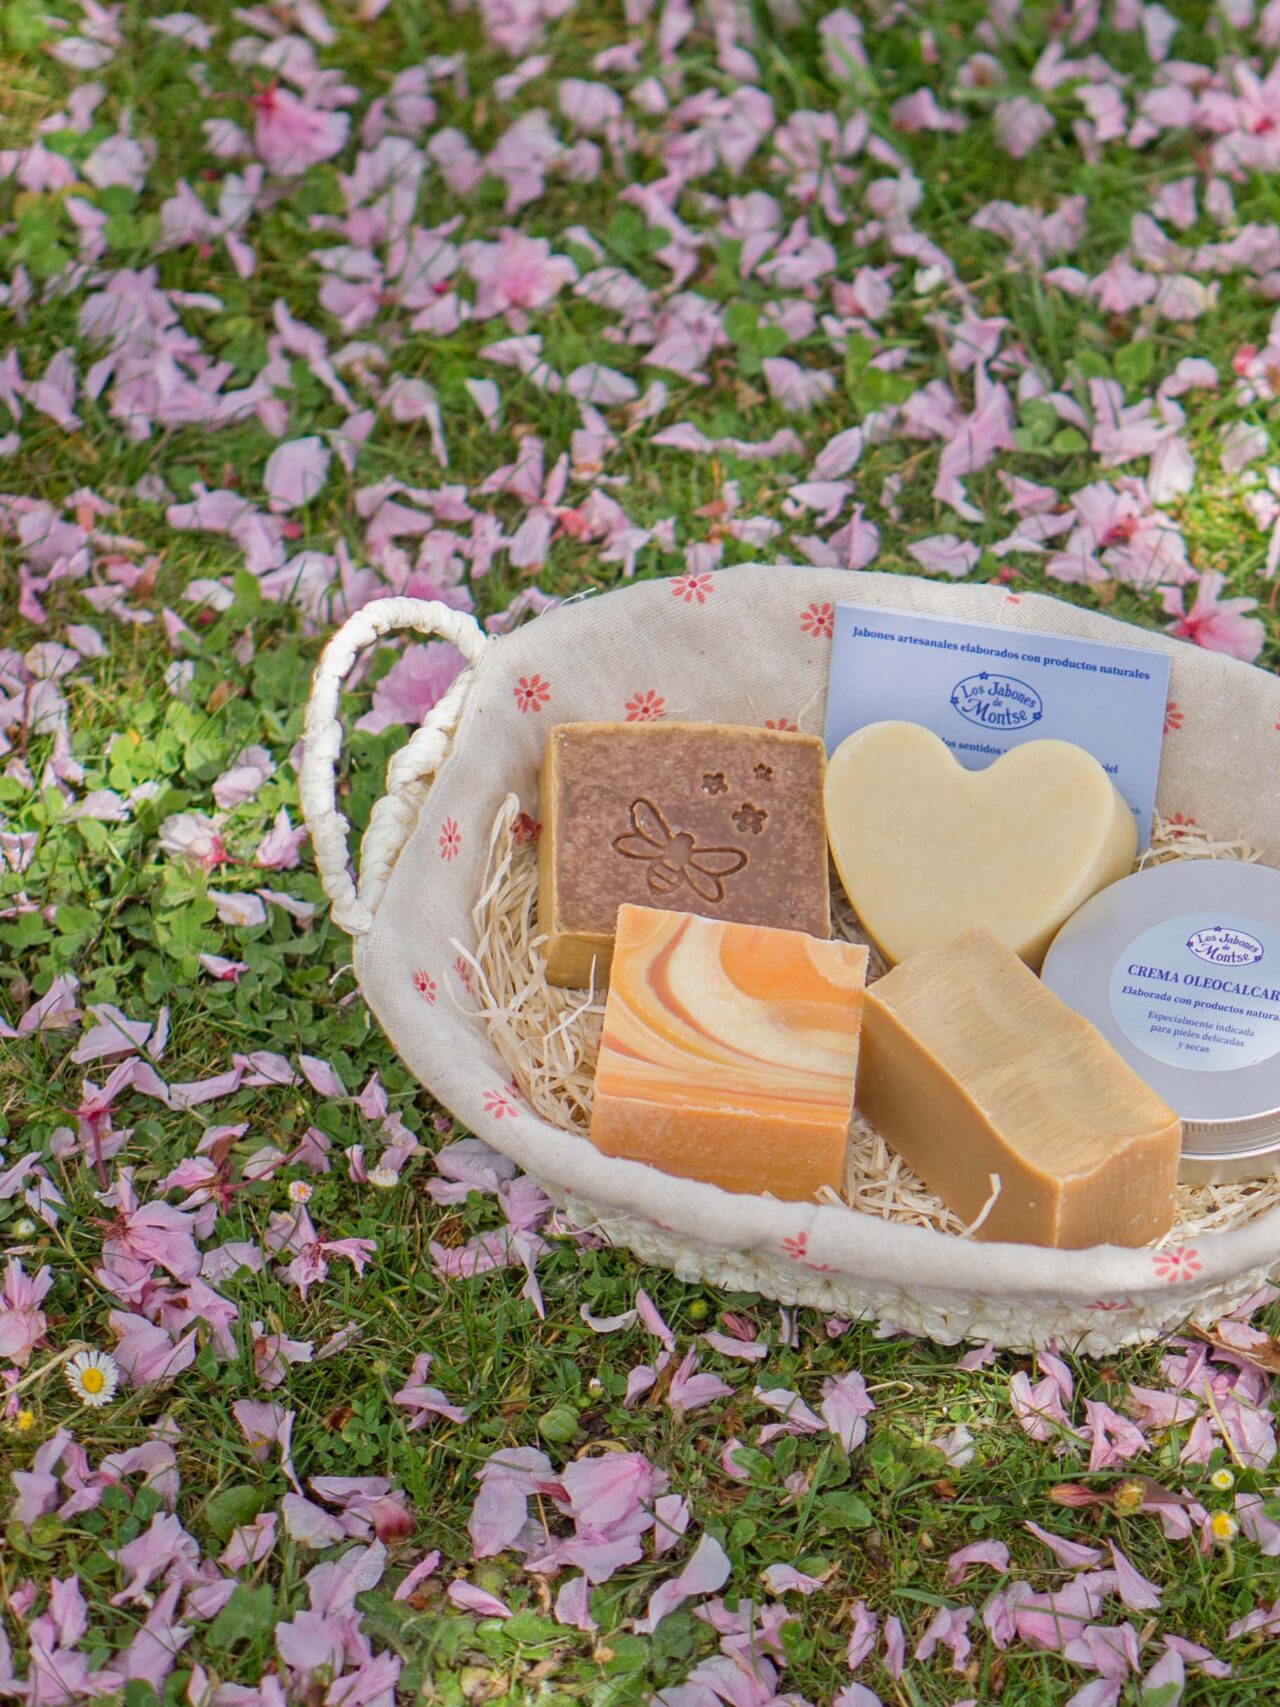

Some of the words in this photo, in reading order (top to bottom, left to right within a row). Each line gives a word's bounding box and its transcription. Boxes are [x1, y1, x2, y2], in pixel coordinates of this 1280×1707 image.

[852, 626, 895, 641] Jabones
[897, 634, 958, 651] artesanales
[960, 643, 1019, 660] elaborados
[1021, 652, 1041, 663] con
[1043, 656, 1097, 673] productos
[1099, 665, 1150, 680] naturales
[961, 684, 985, 699] Los
[987, 681, 1036, 708] Jabones
[992, 697, 1002, 707] de
[961, 698, 1028, 726] Montse
[958, 742, 1001, 755] sentidos
[1195, 943, 1249, 963] Montse
[1197, 933, 1217, 944] Los
[1219, 932, 1259, 953] Jabones
[1127, 963, 1180, 983] CREMA
[1121, 985, 1172, 1002] Elaborada
[1173, 996, 1192, 1006] con
[1193, 1000, 1244, 1015] productos
[1147, 1010, 1215, 1030] Especialmente
[1215, 1022, 1255, 1037] indicada
[1150, 1024, 1172, 1033] para
[1172, 1028, 1200, 1040] pieles
[1201, 1031, 1245, 1048] delicadas
[1176, 1041, 1184, 1051] y
[1185, 1043, 1210, 1054] secas
